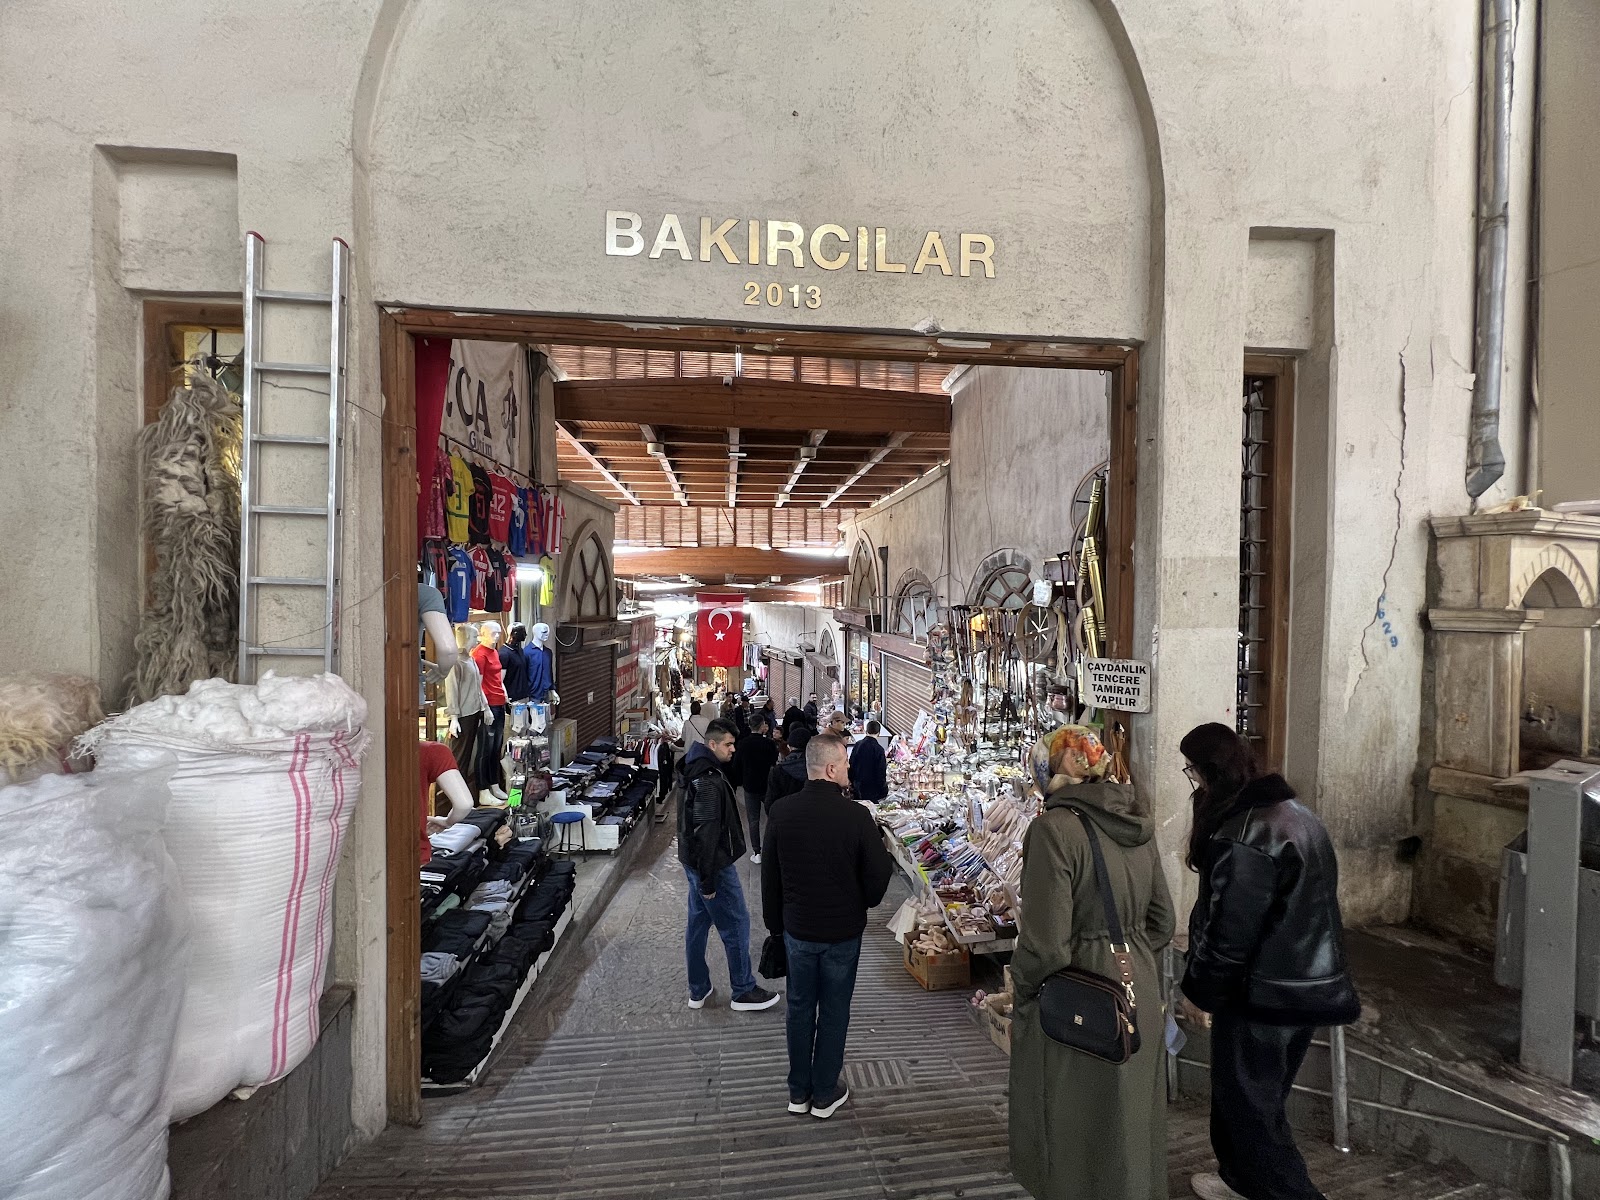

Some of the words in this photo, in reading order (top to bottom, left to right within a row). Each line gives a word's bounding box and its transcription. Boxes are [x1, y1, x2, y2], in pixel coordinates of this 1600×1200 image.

[605, 210, 996, 279] BAKIRCILAR
[743, 281, 823, 310] 2013
[1088, 663, 1146, 674] ÇAYDANLIK
[1093, 674, 1140, 684] TENCERE
[1092, 684, 1140, 696] TAMİRATI
[1095, 695, 1136, 706] YAPILIR
